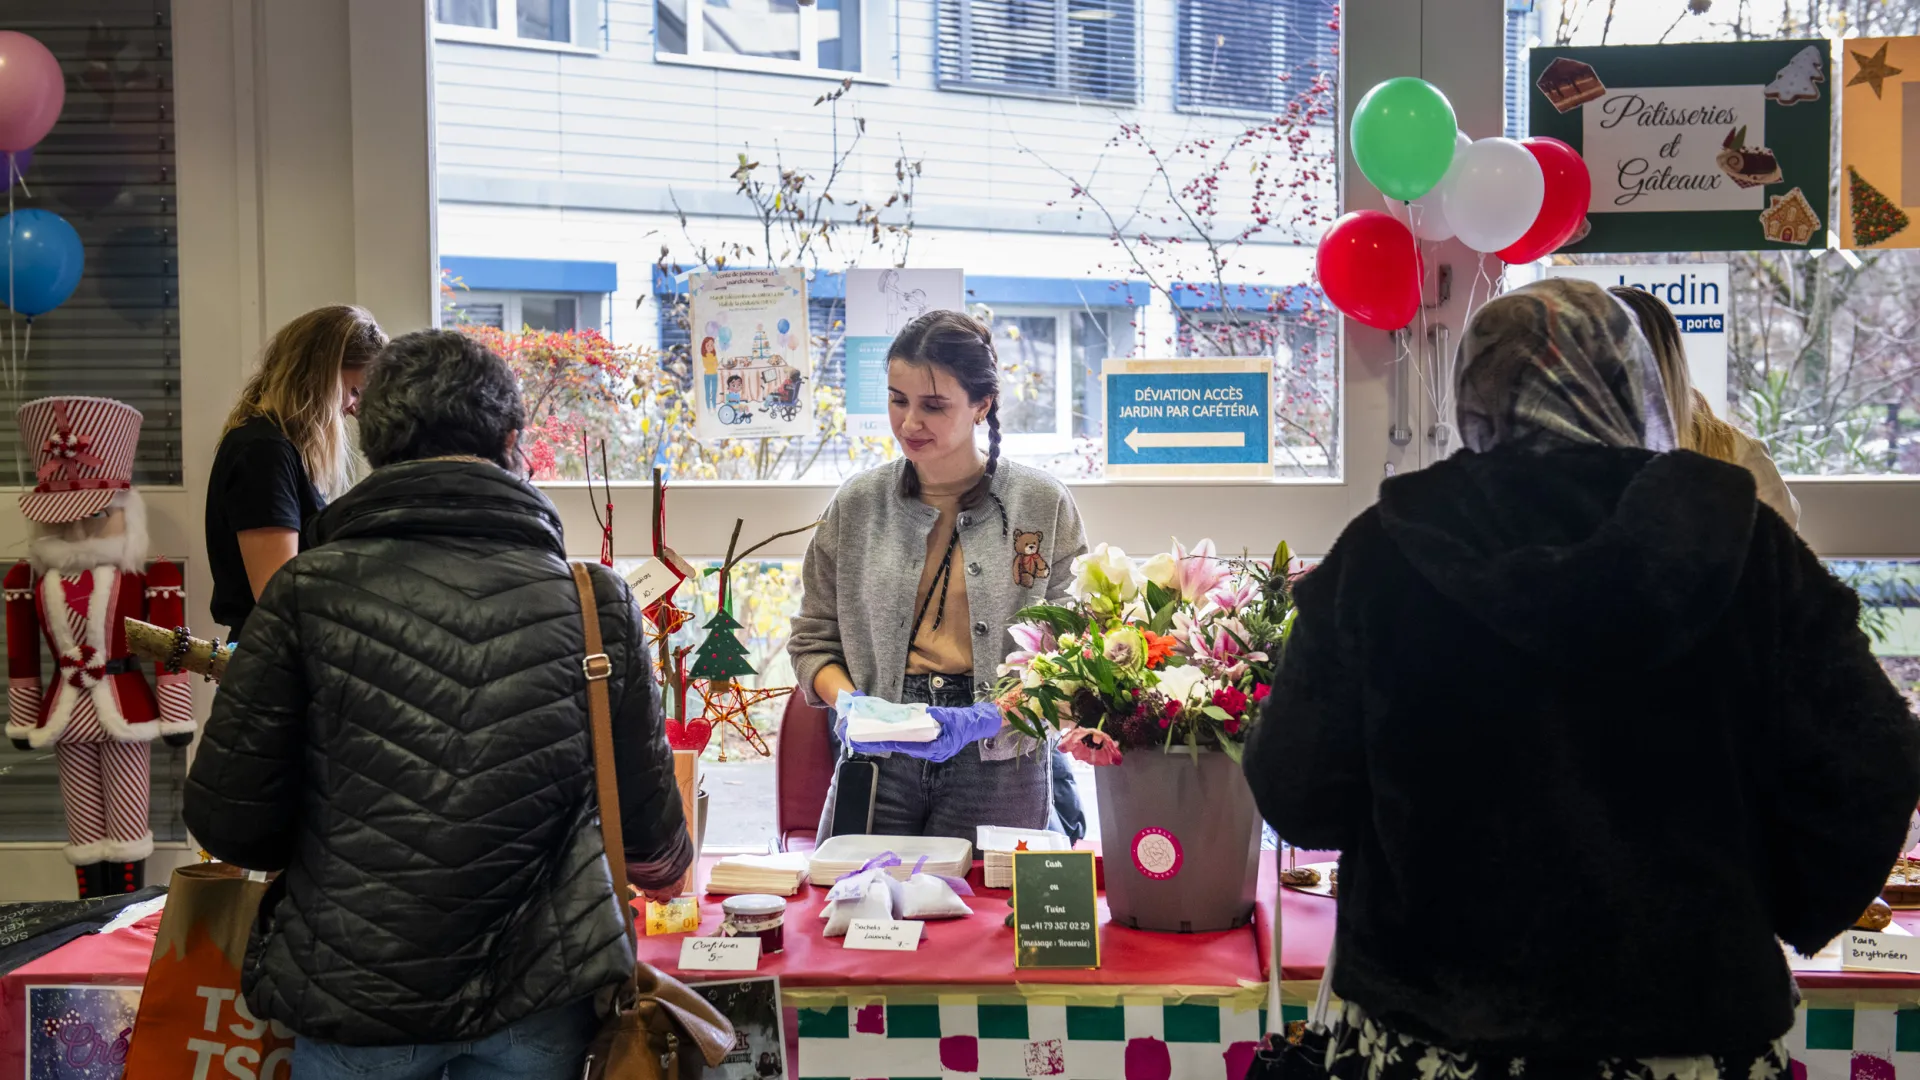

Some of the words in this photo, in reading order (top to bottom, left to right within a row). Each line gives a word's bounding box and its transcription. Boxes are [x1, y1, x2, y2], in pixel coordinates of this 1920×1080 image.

[1600, 94, 1737, 129] Pâtisseries
[1659, 133, 1682, 158] et
[1614, 157, 1722, 205] Gâteaux
[1686, 317, 1721, 331] porte
[1135, 386, 1201, 402] DÉVIATION
[1203, 385, 1243, 401] ACCÈS
[1119, 405, 1163, 418] JARDIN
[1166, 405, 1190, 417] PAR
[1192, 402, 1259, 417] CAFÉTÉRIA
[1045, 860, 1063, 868] Cash
[1044, 905, 1066, 913] Twint
[1044, 922, 1053, 930] 79
[1069, 922, 1079, 930] 02
[1080, 922, 1090, 930] 29
[1852, 936, 1877, 946] Pain
